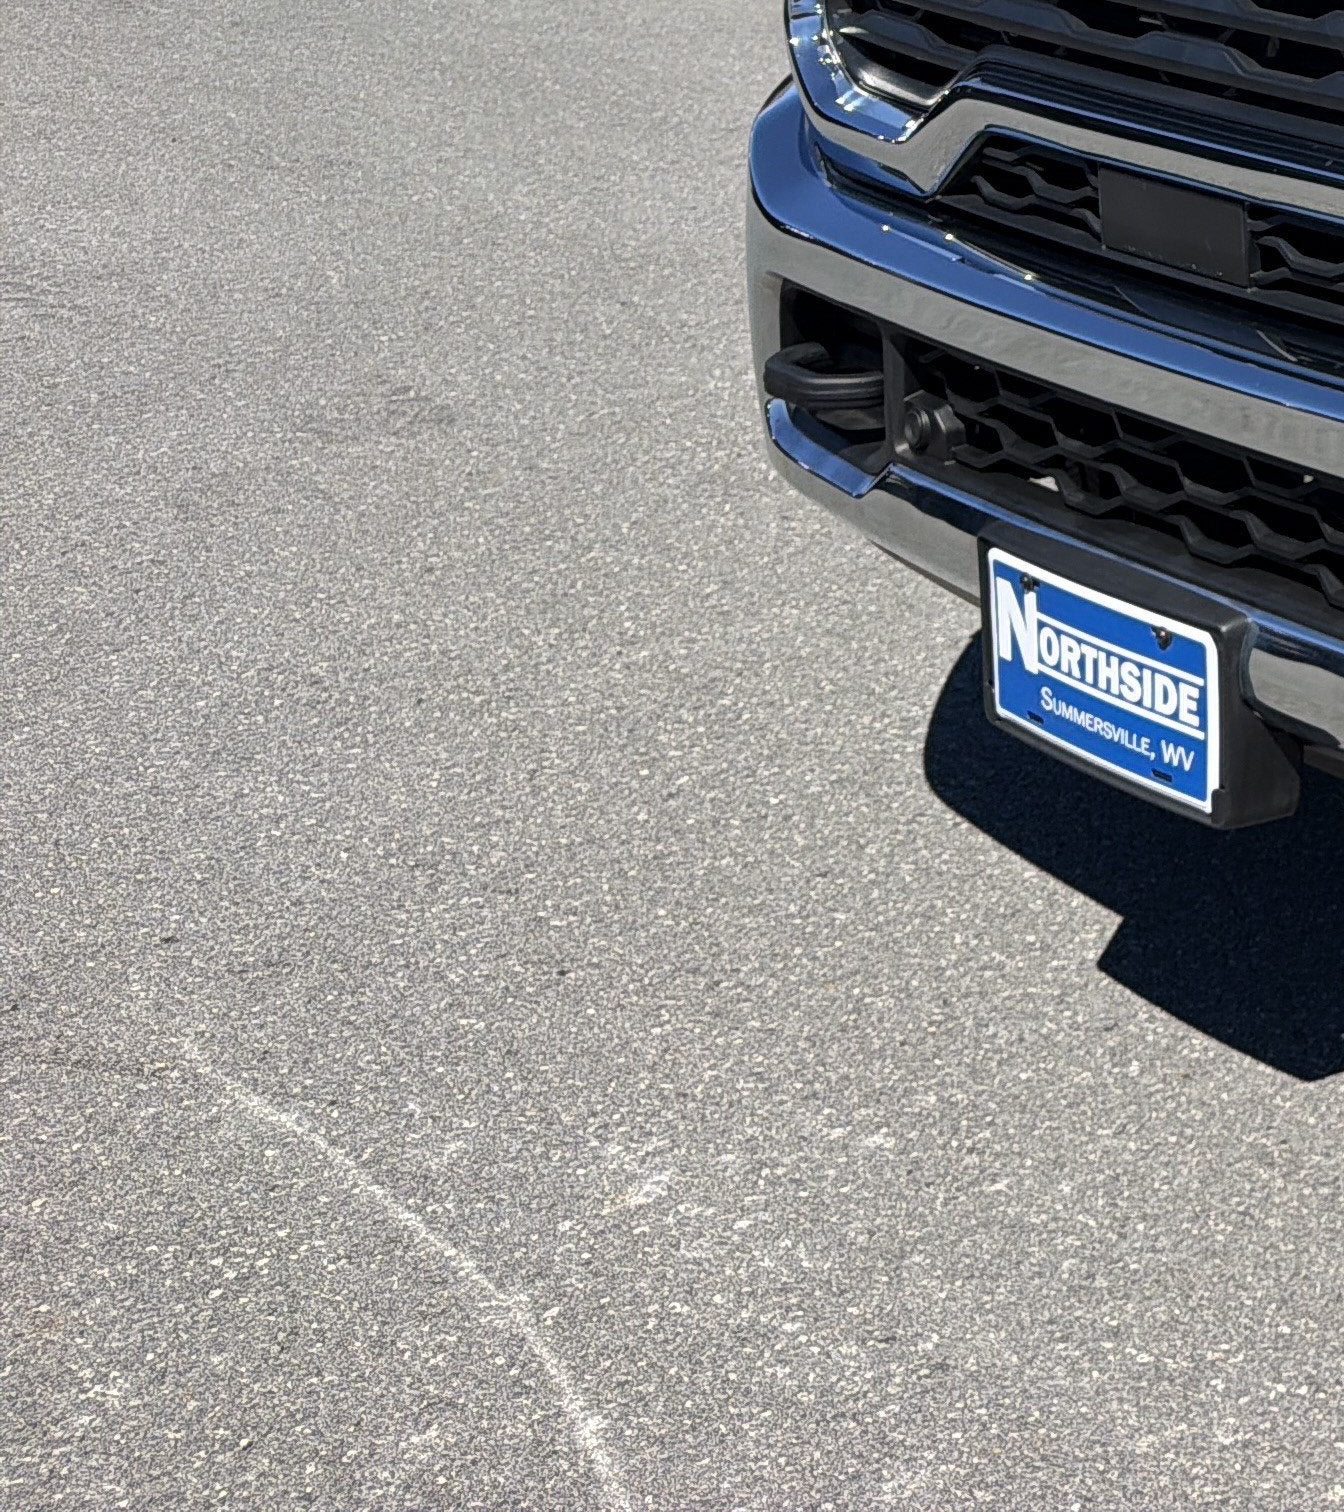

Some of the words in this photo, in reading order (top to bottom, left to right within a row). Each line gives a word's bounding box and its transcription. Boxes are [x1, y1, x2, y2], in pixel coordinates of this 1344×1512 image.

[996, 576, 1200, 727] NORTHSIDE
[1040, 686, 1155, 760] SUMMERSVILLE,
[1161, 739, 1194, 771] WV
